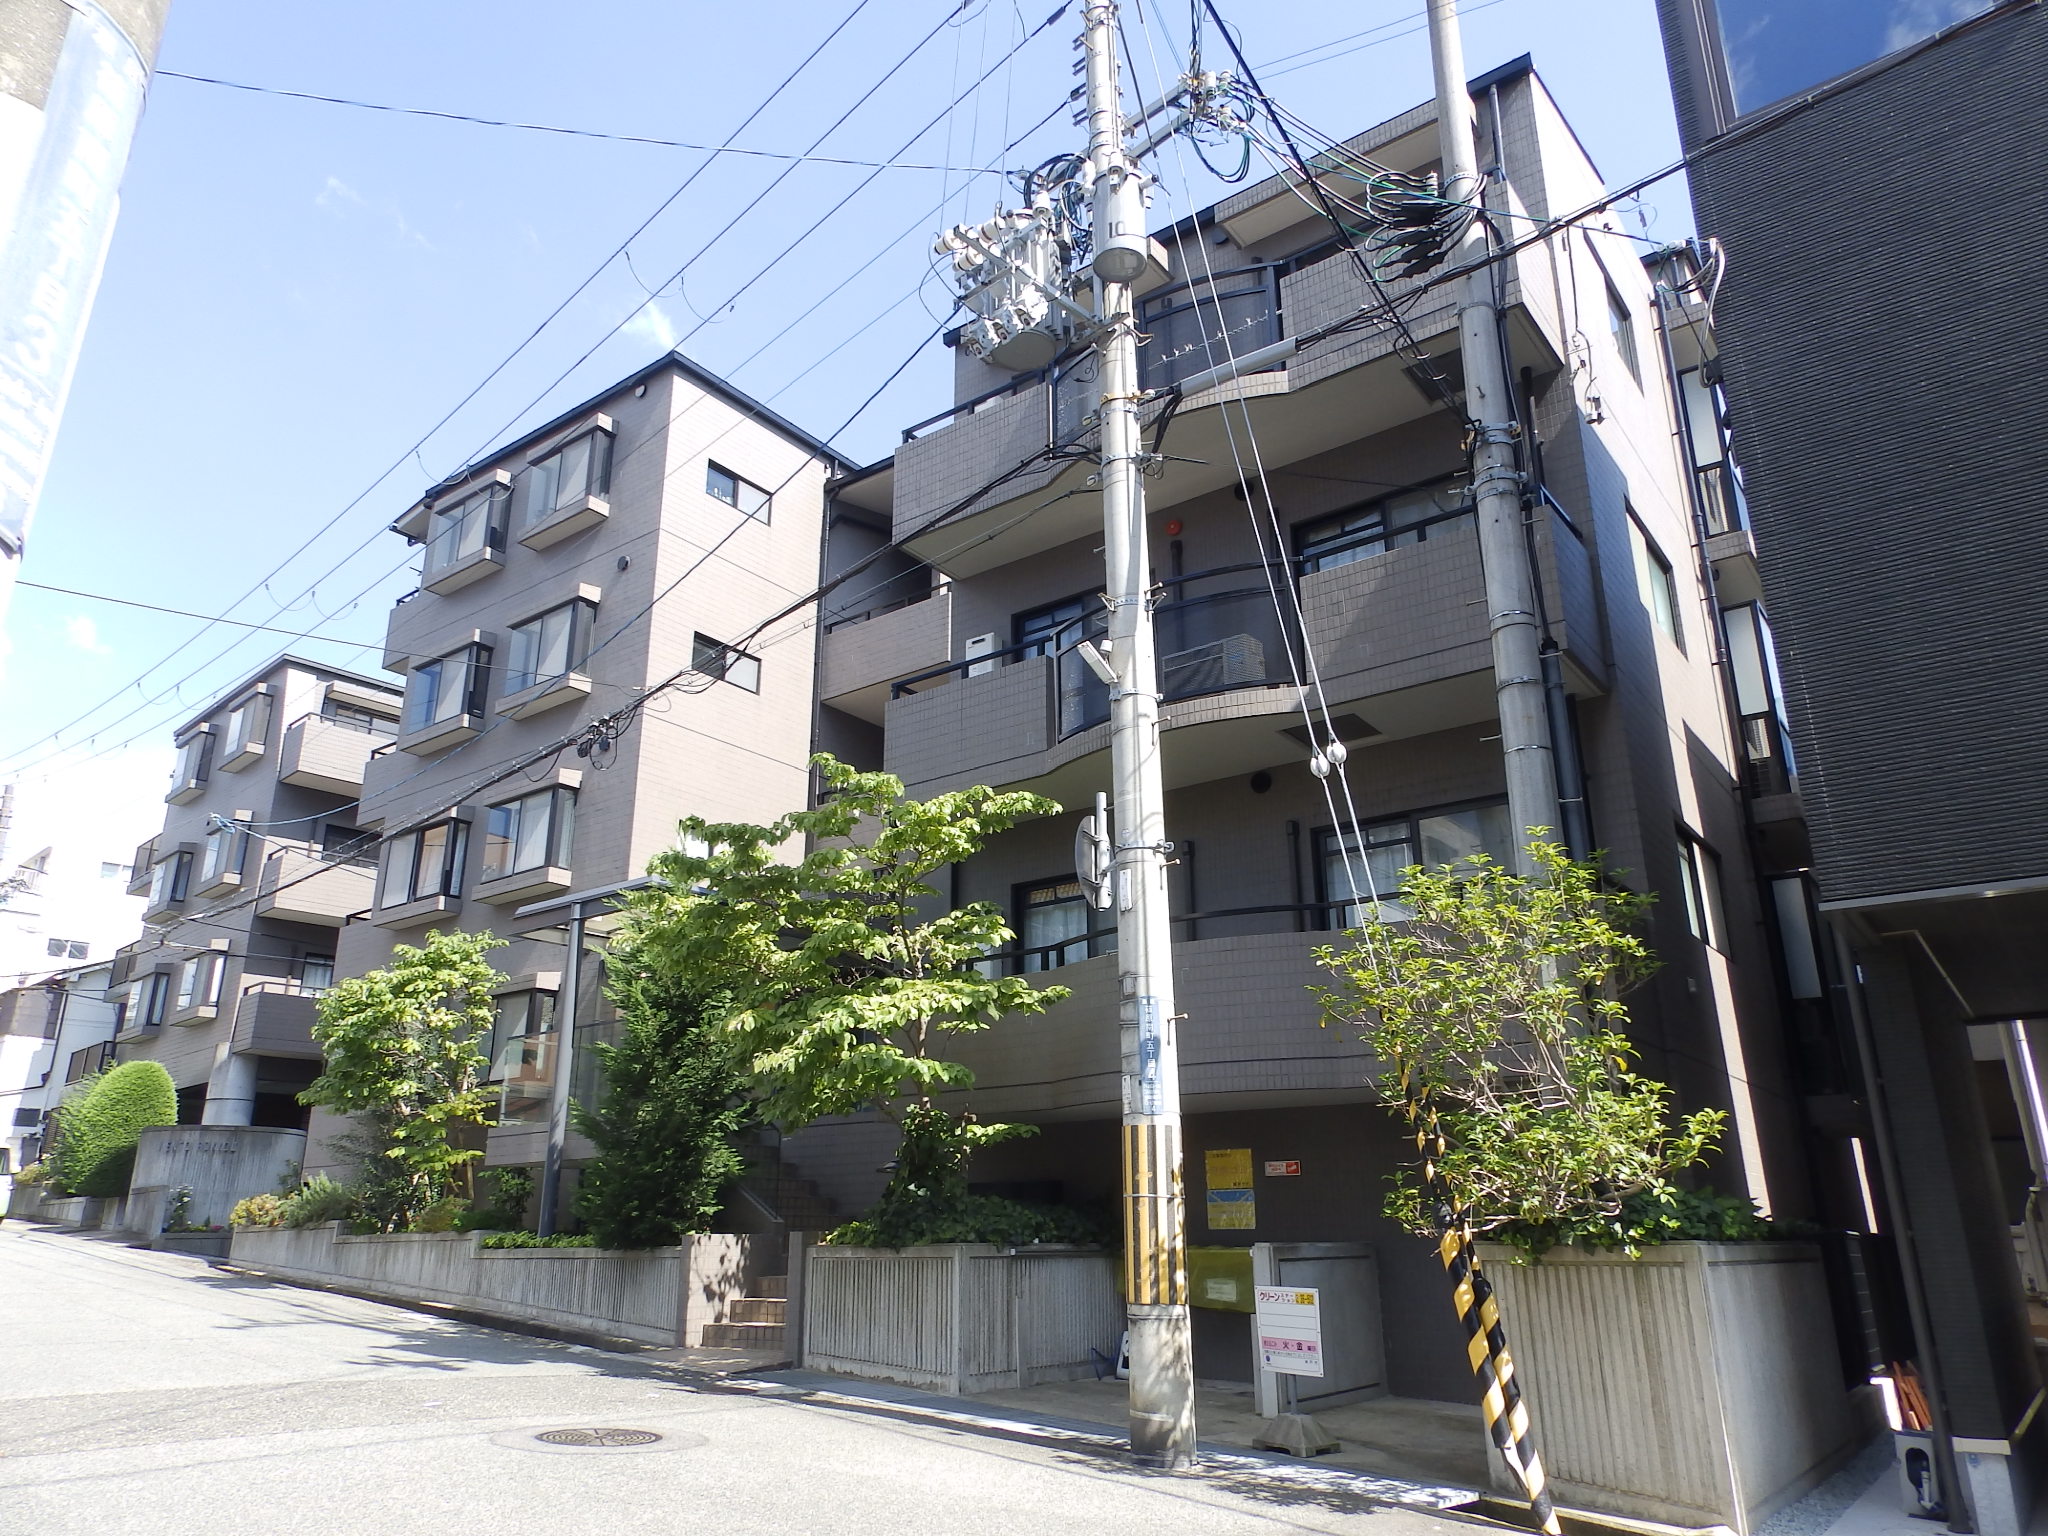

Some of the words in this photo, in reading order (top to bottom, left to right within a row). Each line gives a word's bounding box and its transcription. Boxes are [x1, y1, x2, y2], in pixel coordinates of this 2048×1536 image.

[1259, 1291, 1280, 1302] クリーン
[1282, 1341, 1303, 1351] 火・金
